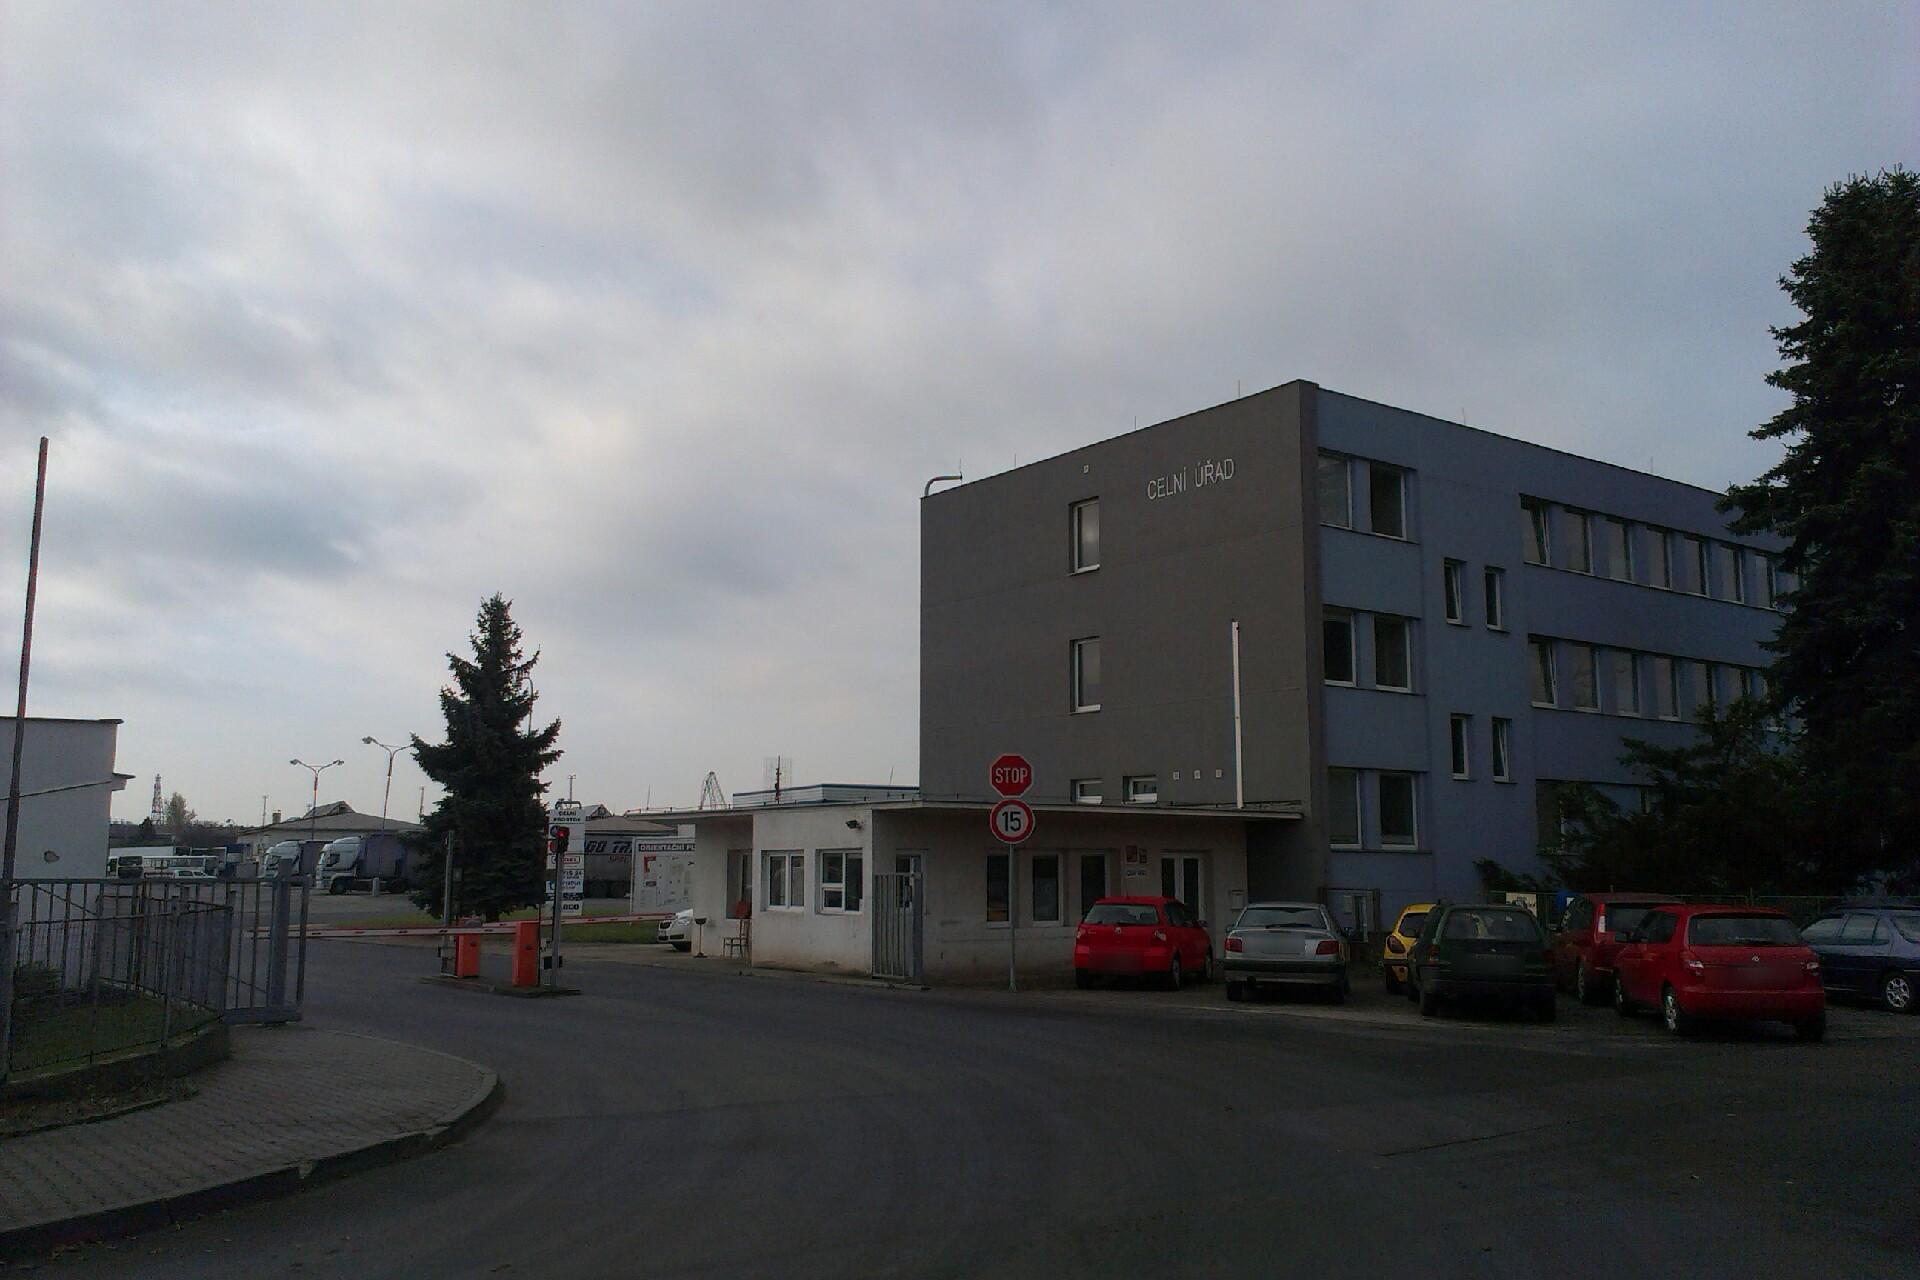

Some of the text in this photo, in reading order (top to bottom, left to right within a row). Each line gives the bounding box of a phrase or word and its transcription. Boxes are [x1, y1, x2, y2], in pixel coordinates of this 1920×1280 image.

[1147, 458, 1235, 500] CELNÍ ÚŘAD
[995, 767, 1028, 784] STOP
[1002, 811, 1021, 832] 15
